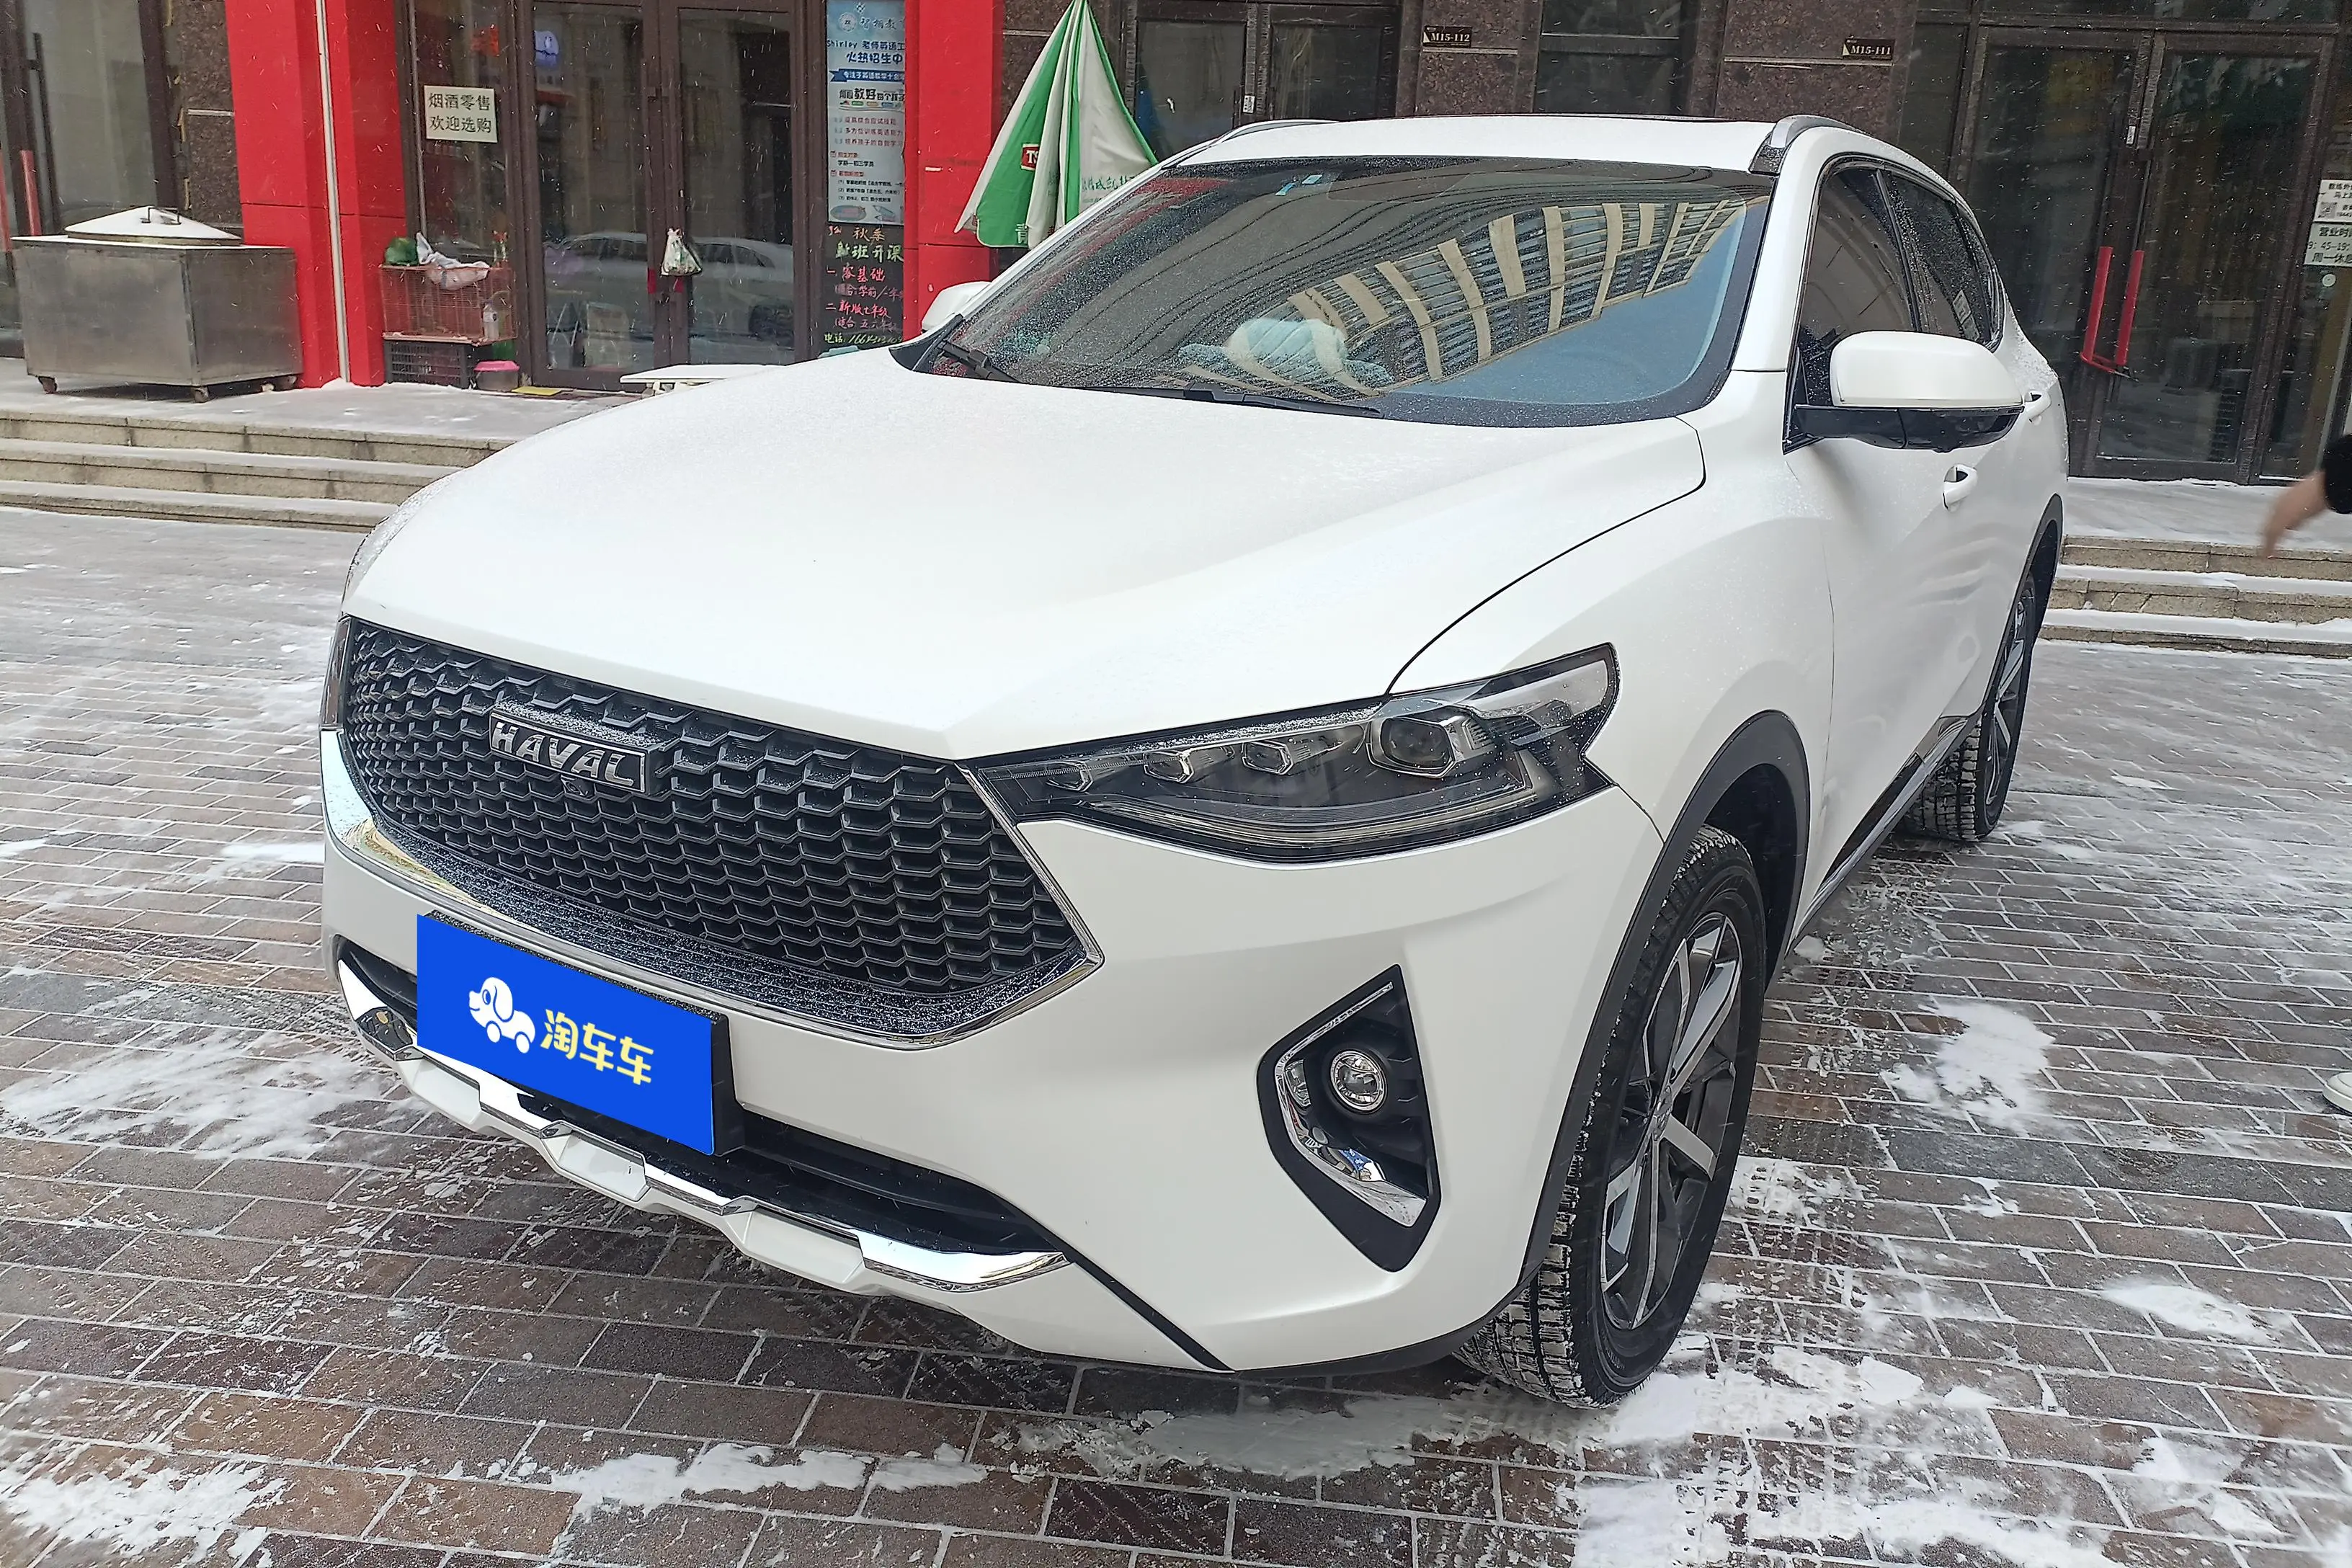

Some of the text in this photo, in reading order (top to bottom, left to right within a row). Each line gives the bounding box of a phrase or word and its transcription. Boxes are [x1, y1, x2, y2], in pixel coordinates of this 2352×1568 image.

[827, 40, 858, 48] Shirley
[1430, 32, 1470, 42] M15-112
[1850, 45, 1892, 55] M15-111
[846, 51, 903, 65] 火热招生中
[428, 92, 491, 111] 烟酒零售
[430, 115, 492, 133] 欢迎选购
[852, 227, 886, 242] 秋季
[1015, 223, 1028, 244] 青
[491, 721, 634, 787] HAVAL
